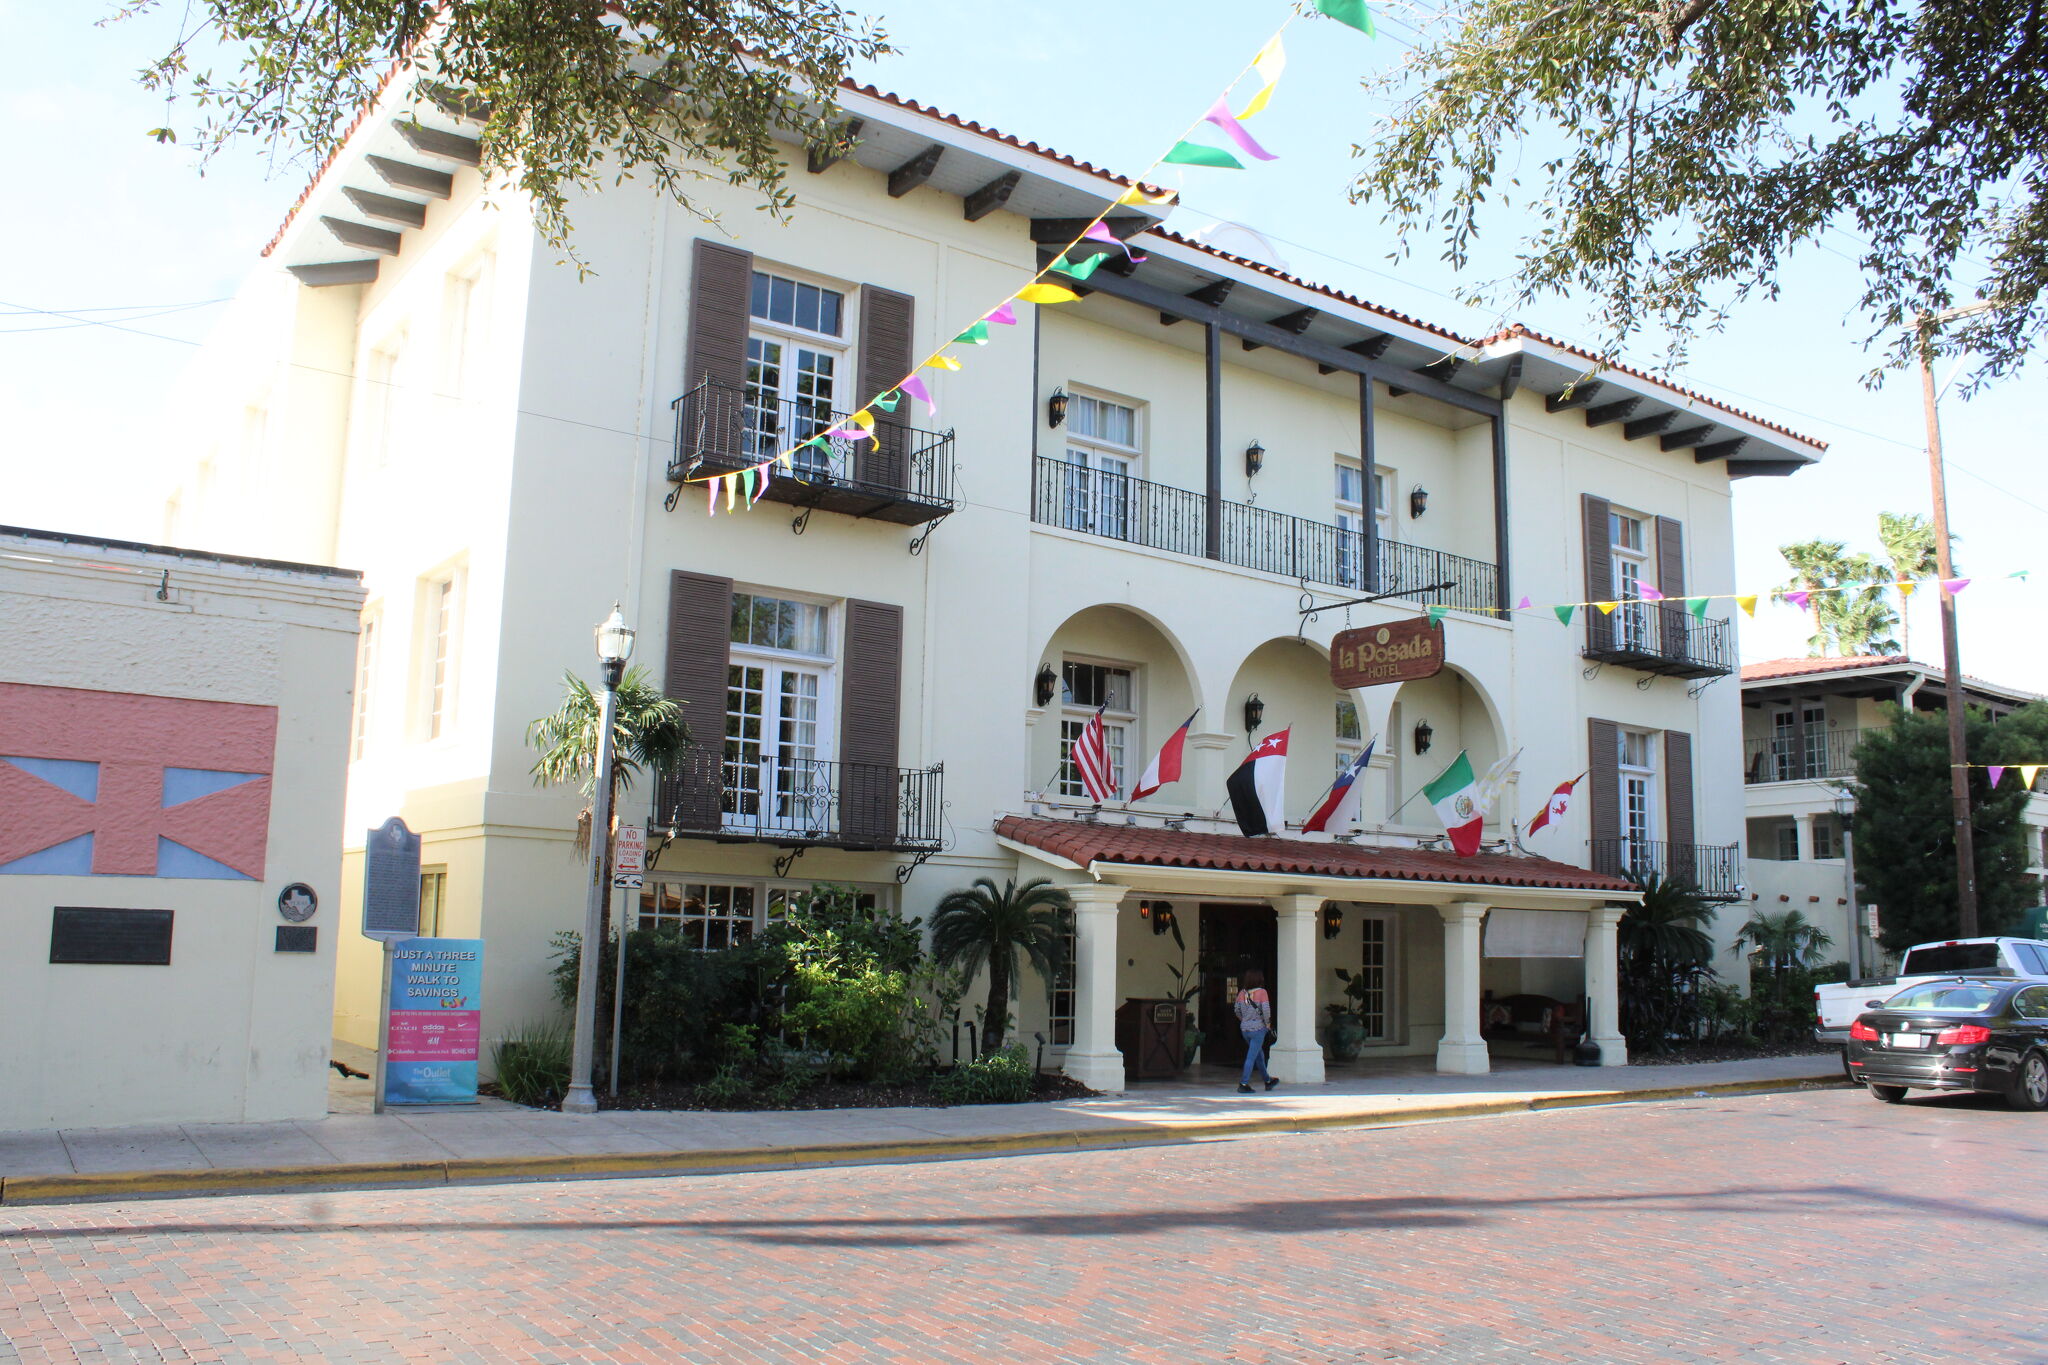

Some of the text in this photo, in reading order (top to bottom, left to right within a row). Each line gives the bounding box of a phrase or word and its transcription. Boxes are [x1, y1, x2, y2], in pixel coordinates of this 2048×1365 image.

[1338, 633, 1432, 673] la Posada
[1368, 663, 1403, 679] HOTEL
[626, 830, 637, 840] NO
[618, 840, 644, 850] PARKING
[394, 950, 476, 961] JUST A THREE
[411, 963, 457, 973] MINUTE
[407, 975, 460, 985] WALK TO
[407, 987, 459, 998] SAVINGS
[423, 1066, 451, 1078] Outlet
